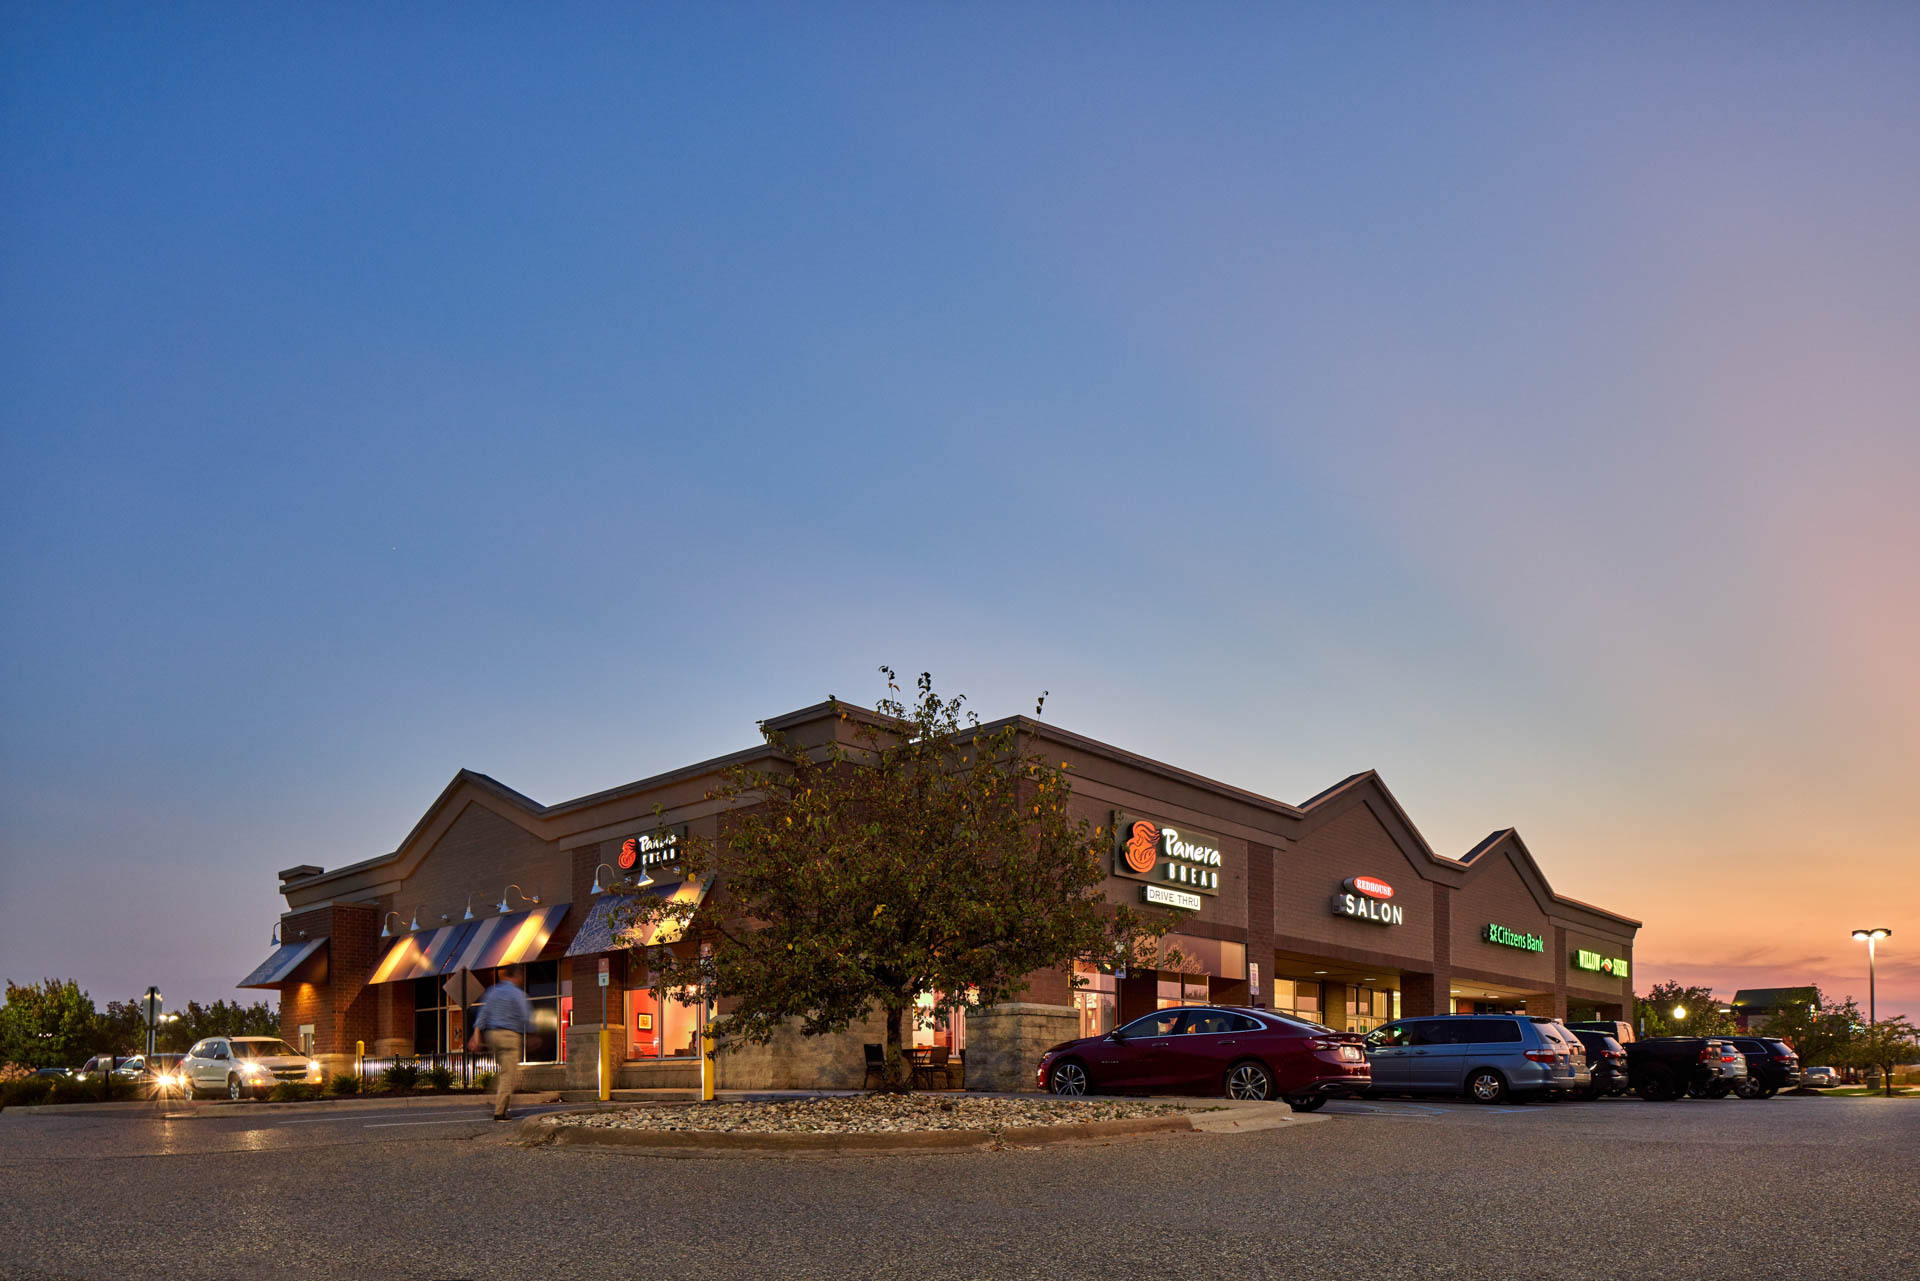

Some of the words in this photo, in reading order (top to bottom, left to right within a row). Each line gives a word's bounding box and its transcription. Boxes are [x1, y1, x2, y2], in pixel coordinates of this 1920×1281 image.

[1161, 828, 1222, 867] Panera
[1169, 862, 1217, 888] BREAD
[1356, 879, 1392, 896] REDHOUSE
[1149, 889, 1174, 902] DRIVE
[1177, 895, 1199, 907] THRU
[1345, 893, 1403, 926] SALON
[1497, 926, 1526, 949] Citizens
[1527, 933, 1544, 952] Bank
[1578, 949, 1601, 972] WILLOW
